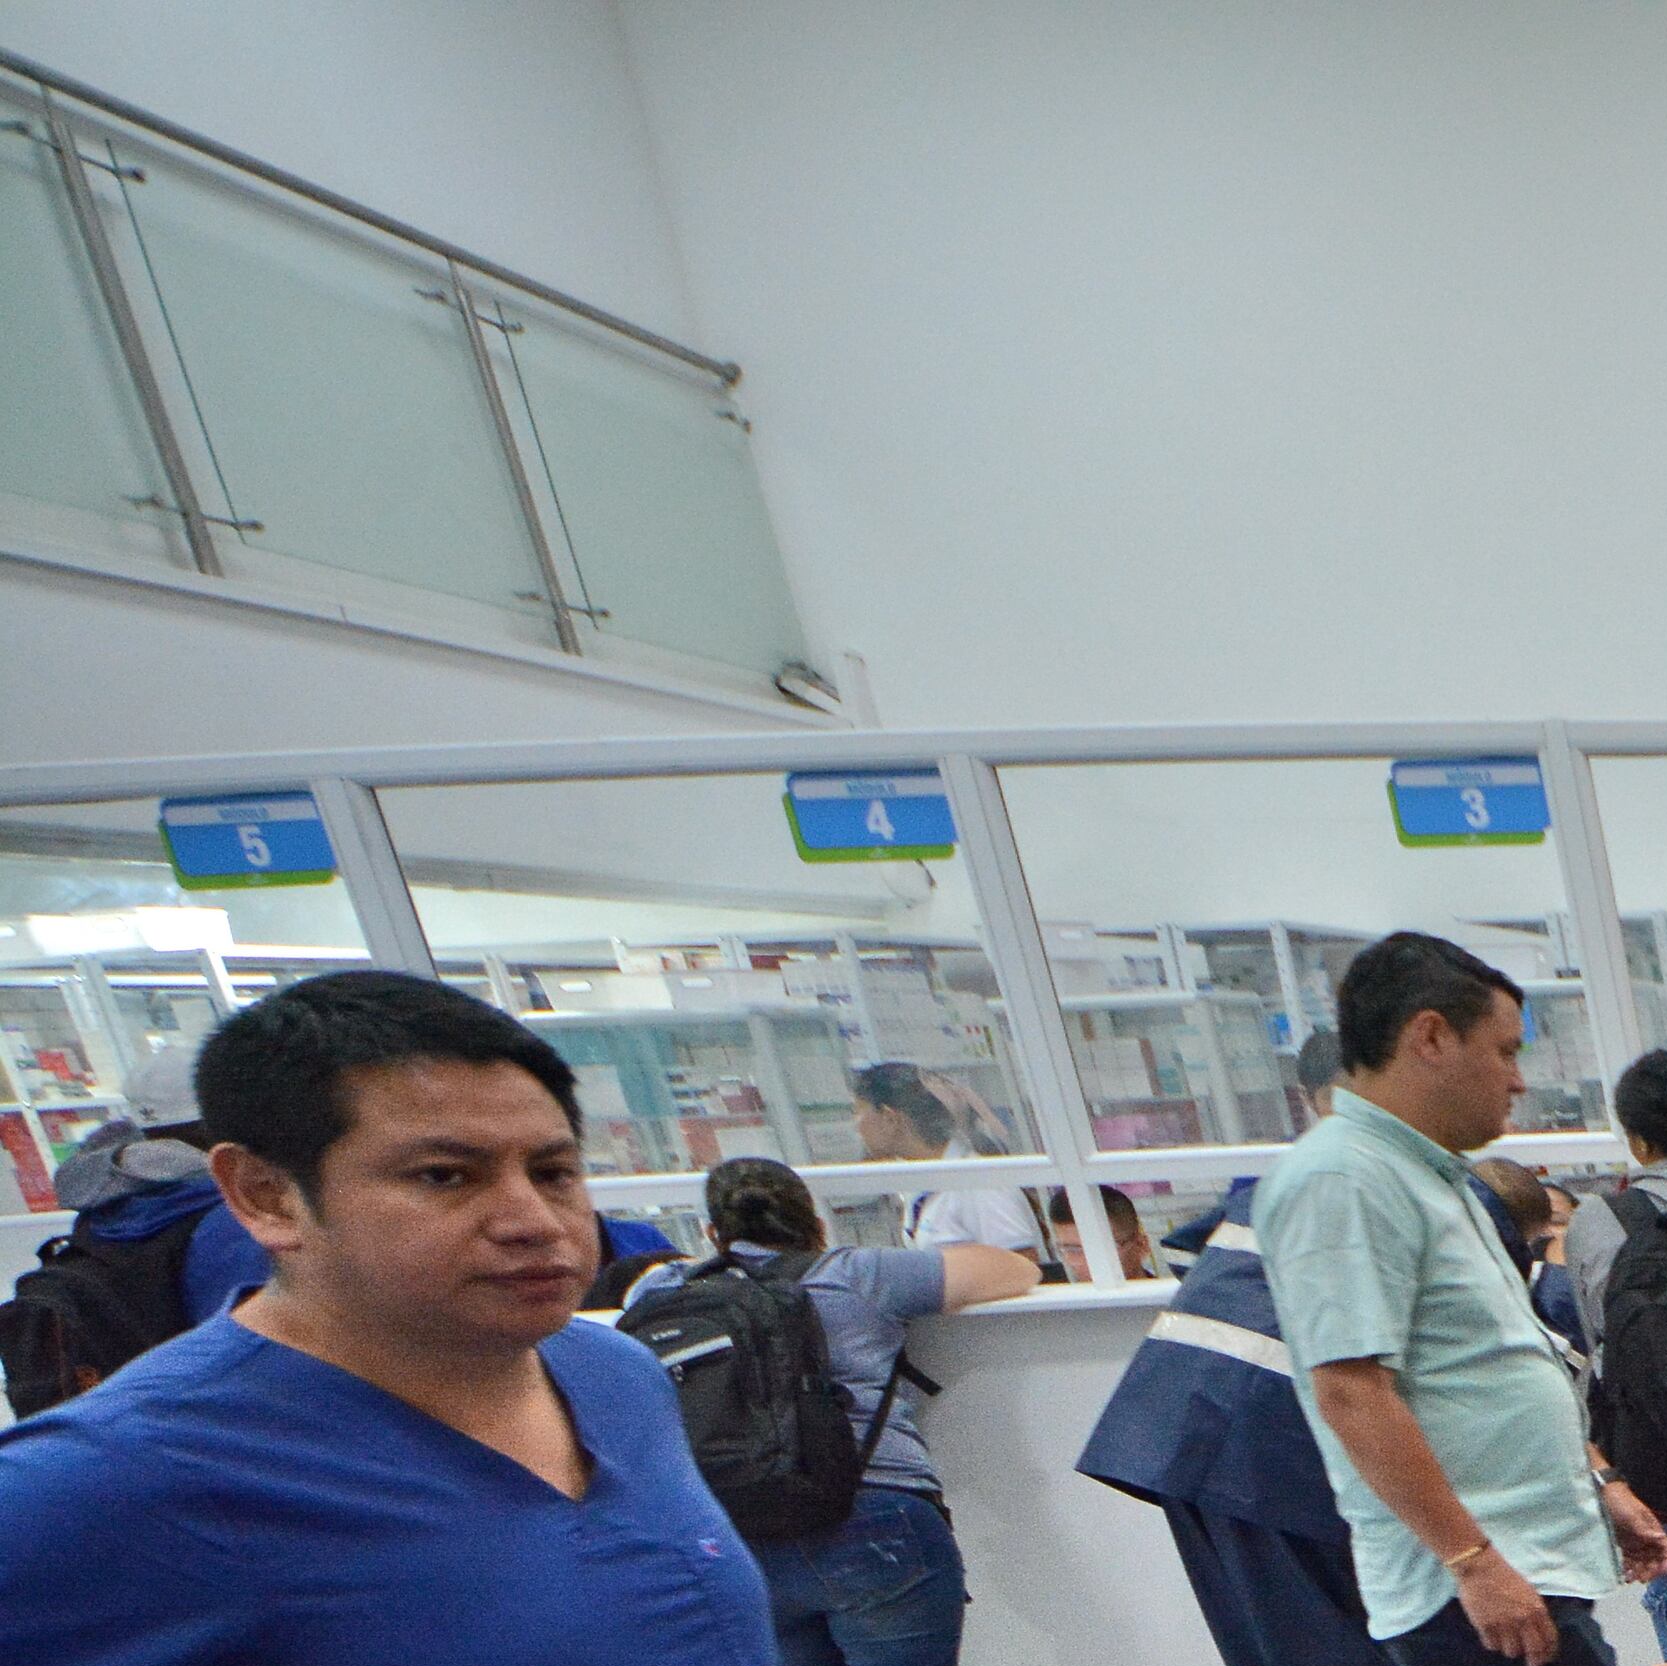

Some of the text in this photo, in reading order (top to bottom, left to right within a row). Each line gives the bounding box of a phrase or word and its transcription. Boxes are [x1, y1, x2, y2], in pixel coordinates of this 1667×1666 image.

[867, 799, 896, 841] 4
[1460, 788, 1491, 829] 3
[237, 824, 271, 866] 5
